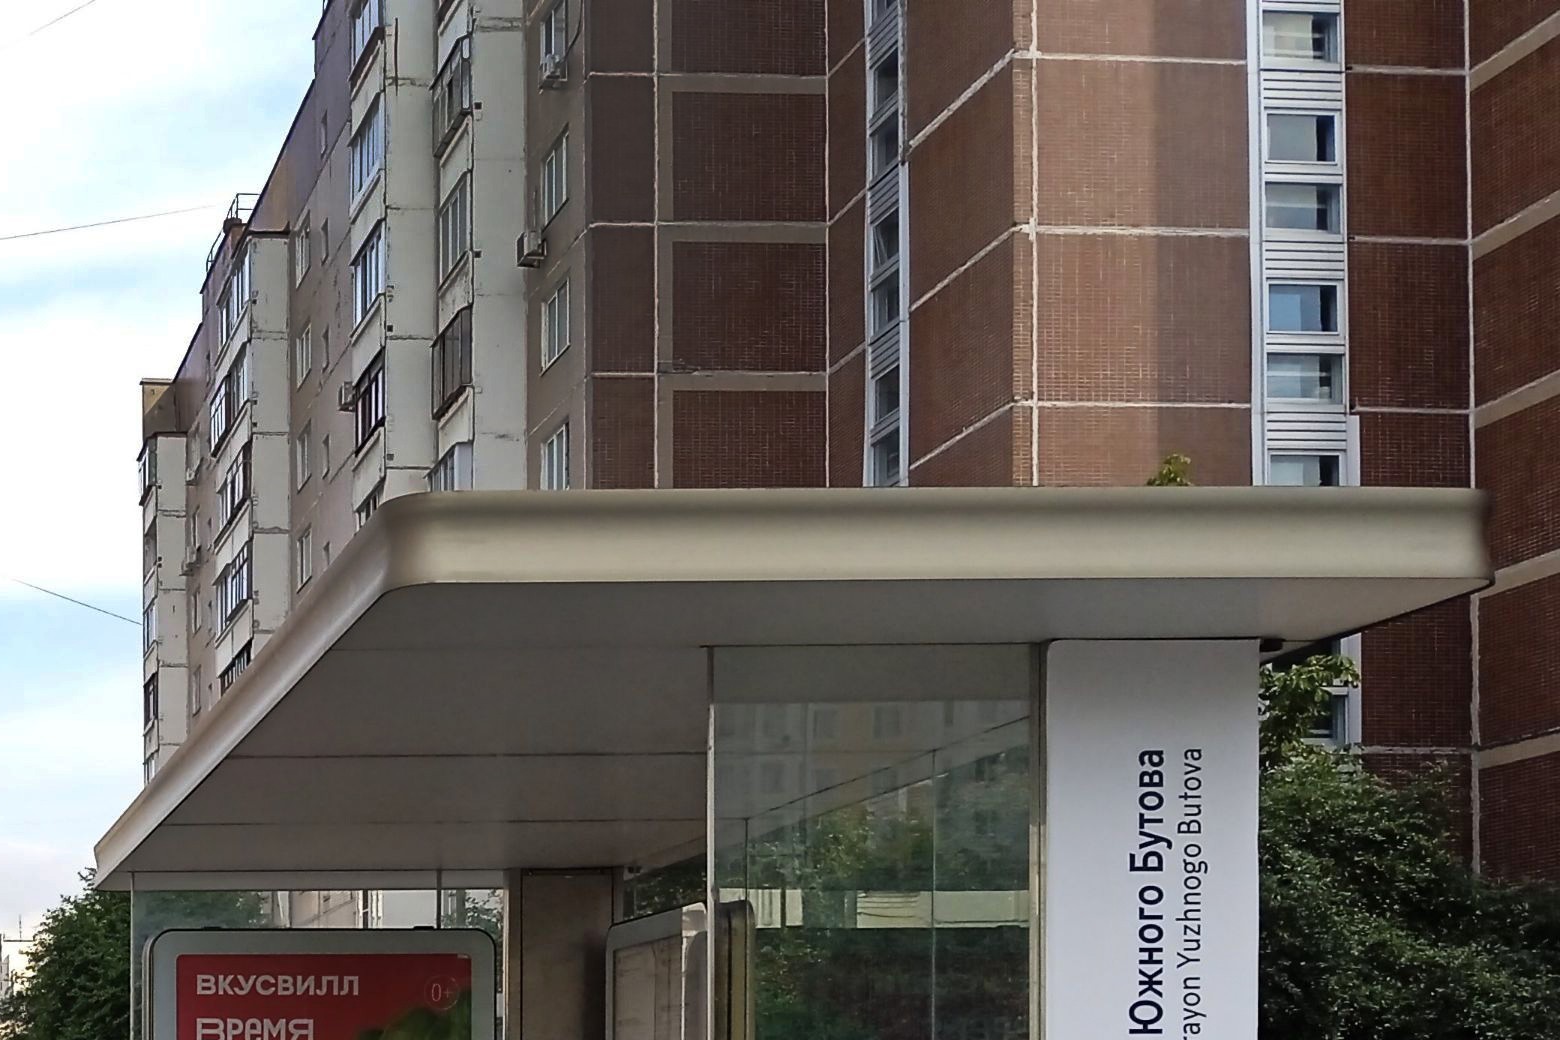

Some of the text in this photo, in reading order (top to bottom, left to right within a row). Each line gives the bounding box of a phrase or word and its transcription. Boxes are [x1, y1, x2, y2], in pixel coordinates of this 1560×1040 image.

[1128, 748, 1173, 872] Бутова
[1177, 748, 1202, 834] Butova
[1128, 884, 1164, 1034] Южного
[1175, 843, 1208, 969] Yuzhnogo
[196, 974, 359, 996] ВКУСВИЛЛ
